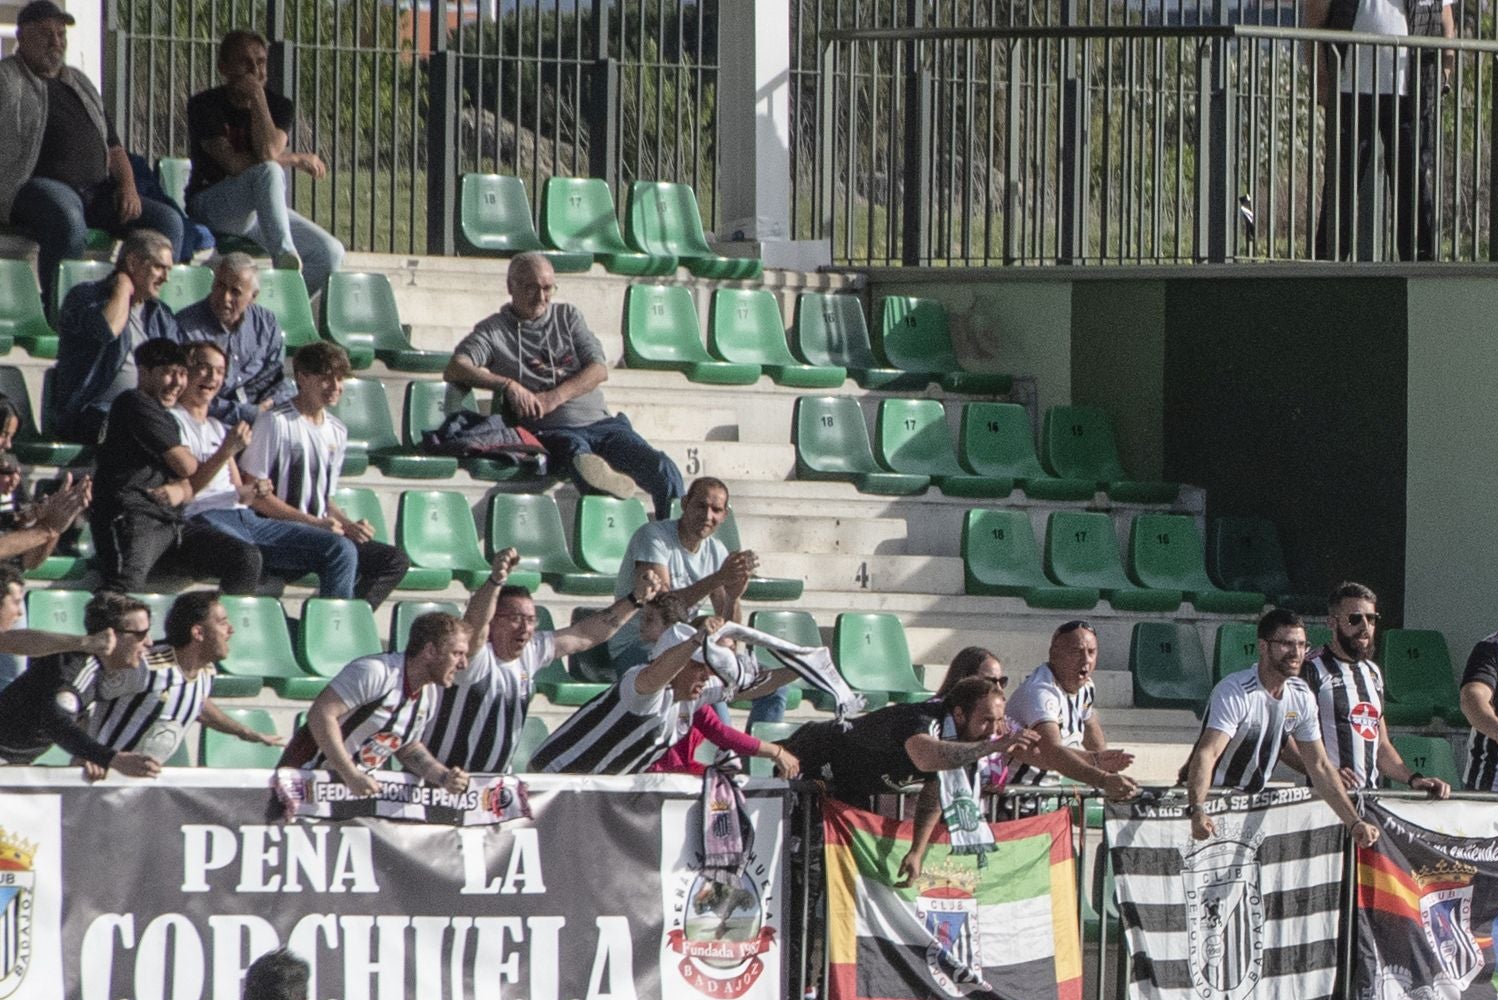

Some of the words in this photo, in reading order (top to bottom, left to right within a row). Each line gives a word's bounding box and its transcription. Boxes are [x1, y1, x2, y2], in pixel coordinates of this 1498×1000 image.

[484, 193, 496, 204] 18
[821, 416, 834, 428] 18
[904, 420, 917, 431] 17
[607, 517, 616, 529] 2
[1074, 531, 1087, 543] 17
[855, 562, 869, 589] 4
[1243, 643, 1256, 655] 17
[1413, 757, 1426, 768] 17
[412, 786, 430, 804] DE
[1159, 798, 1228, 818] HISRIA
[1231, 795, 1248, 811] SE
[1252, 787, 1312, 808] ESCRIBE
[459, 827, 546, 895] LA
[682, 943, 734, 958] Fundada
[683, 963, 759, 994] BADAJOZ
